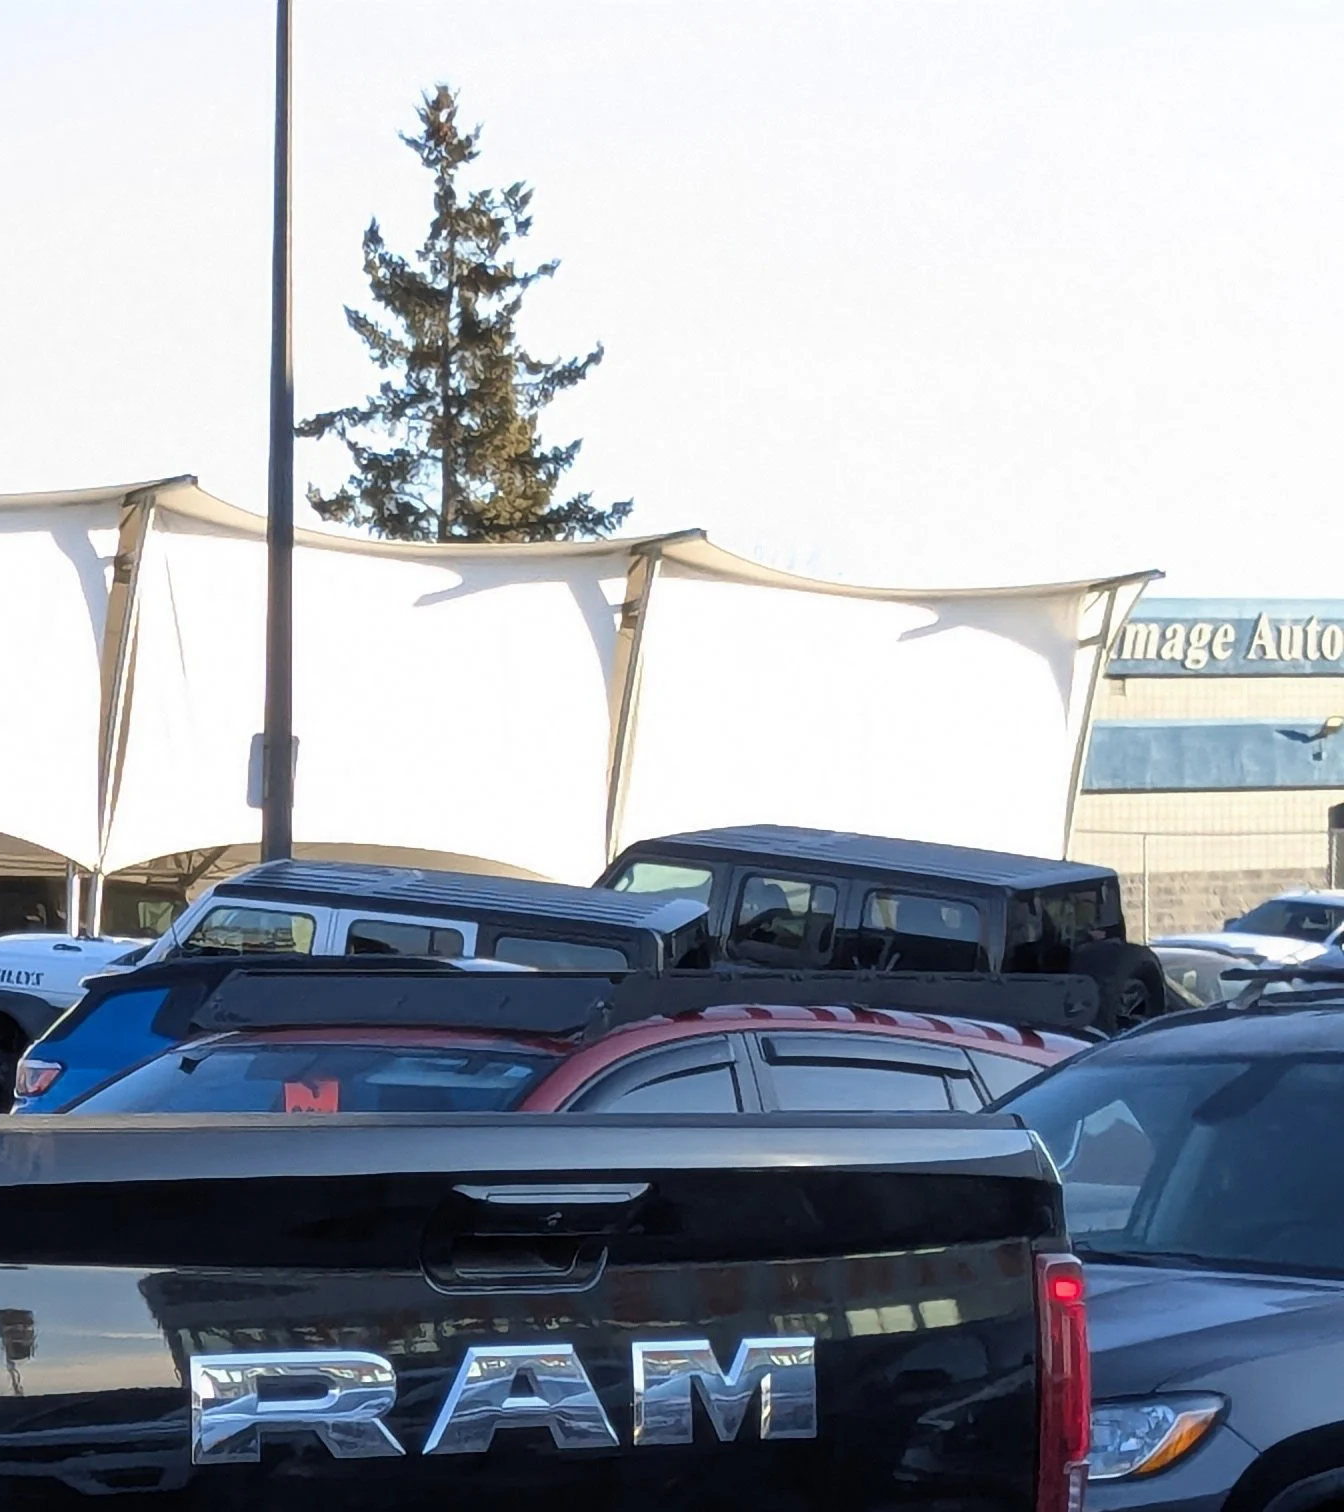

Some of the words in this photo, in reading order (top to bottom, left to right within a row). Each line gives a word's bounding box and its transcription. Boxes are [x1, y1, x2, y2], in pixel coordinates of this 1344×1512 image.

[1111, 622, 1236, 670] mage
[1245, 611, 1344, 661] Auto
[191, 1337, 817, 1464] RAM
